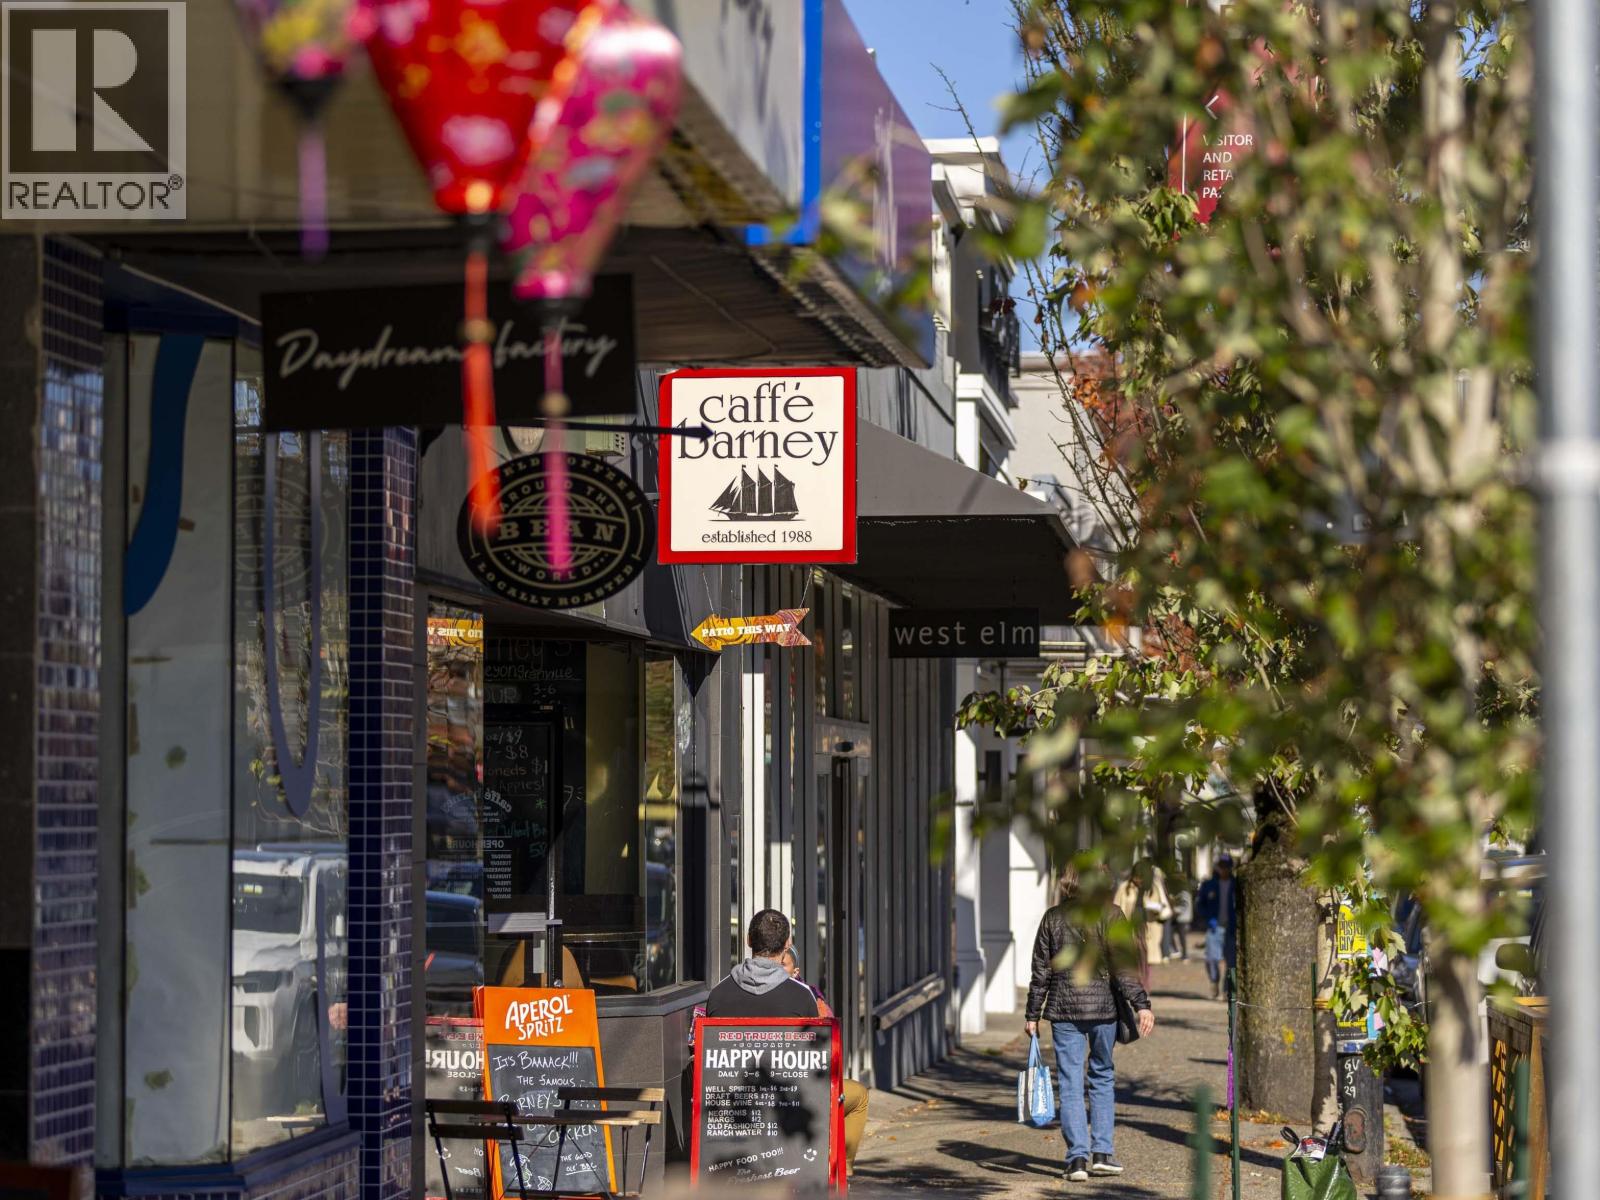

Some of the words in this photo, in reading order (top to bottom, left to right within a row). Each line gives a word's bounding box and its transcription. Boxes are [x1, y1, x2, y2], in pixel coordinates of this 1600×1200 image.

[1202, 134, 1253, 146] VSITOR
[1202, 151, 1232, 163] AND
[1203, 169, 1233, 181] RETA
[699, 381, 814, 424] caffé
[676, 417, 839, 467] barney
[566, 456, 638, 502] OFFEES
[498, 478, 574, 512] AROUD
[585, 485, 618, 515] THE
[496, 518, 618, 543] BEAN
[701, 530, 776, 544] established
[781, 530, 813, 543] 1988
[516, 564, 593, 582] WORLD
[476, 562, 553, 607] LOCALLY
[556, 564, 635, 607] ROASTED
[701, 627, 735, 637] PATIO
[737, 625, 764, 635] THIS
[764, 623, 792, 634] WAY
[894, 621, 967, 646] west
[980, 621, 1035, 646] elm
[505, 994, 574, 1030] APEROL
[718, 1031, 743, 1042] RED
[745, 1031, 783, 1042] TRUCK
[784, 1031, 817, 1042] BEER
[705, 1048, 765, 1070] HAPPY
[770, 1050, 829, 1071] HOUR!
[517, 1075, 534, 1086] THE
[1346, 1071, 1355, 1085] 5
[705, 1085, 726, 1093] WELL
[728, 1085, 756, 1093] SPIRITS
[1343, 1085, 1356, 1099] 29
[708, 1109, 747, 1117] NEGRONIS
[706, 1129, 734, 1137] RANCH
[735, 1129, 762, 1137] WATER
[766, 1128, 778, 1137] $10
[766, 1122, 778, 1130] $12
[707, 1160, 734, 1173] HAPPY
[736, 1154, 759, 1166] FOOD
[773, 1167, 801, 1177] Beer
